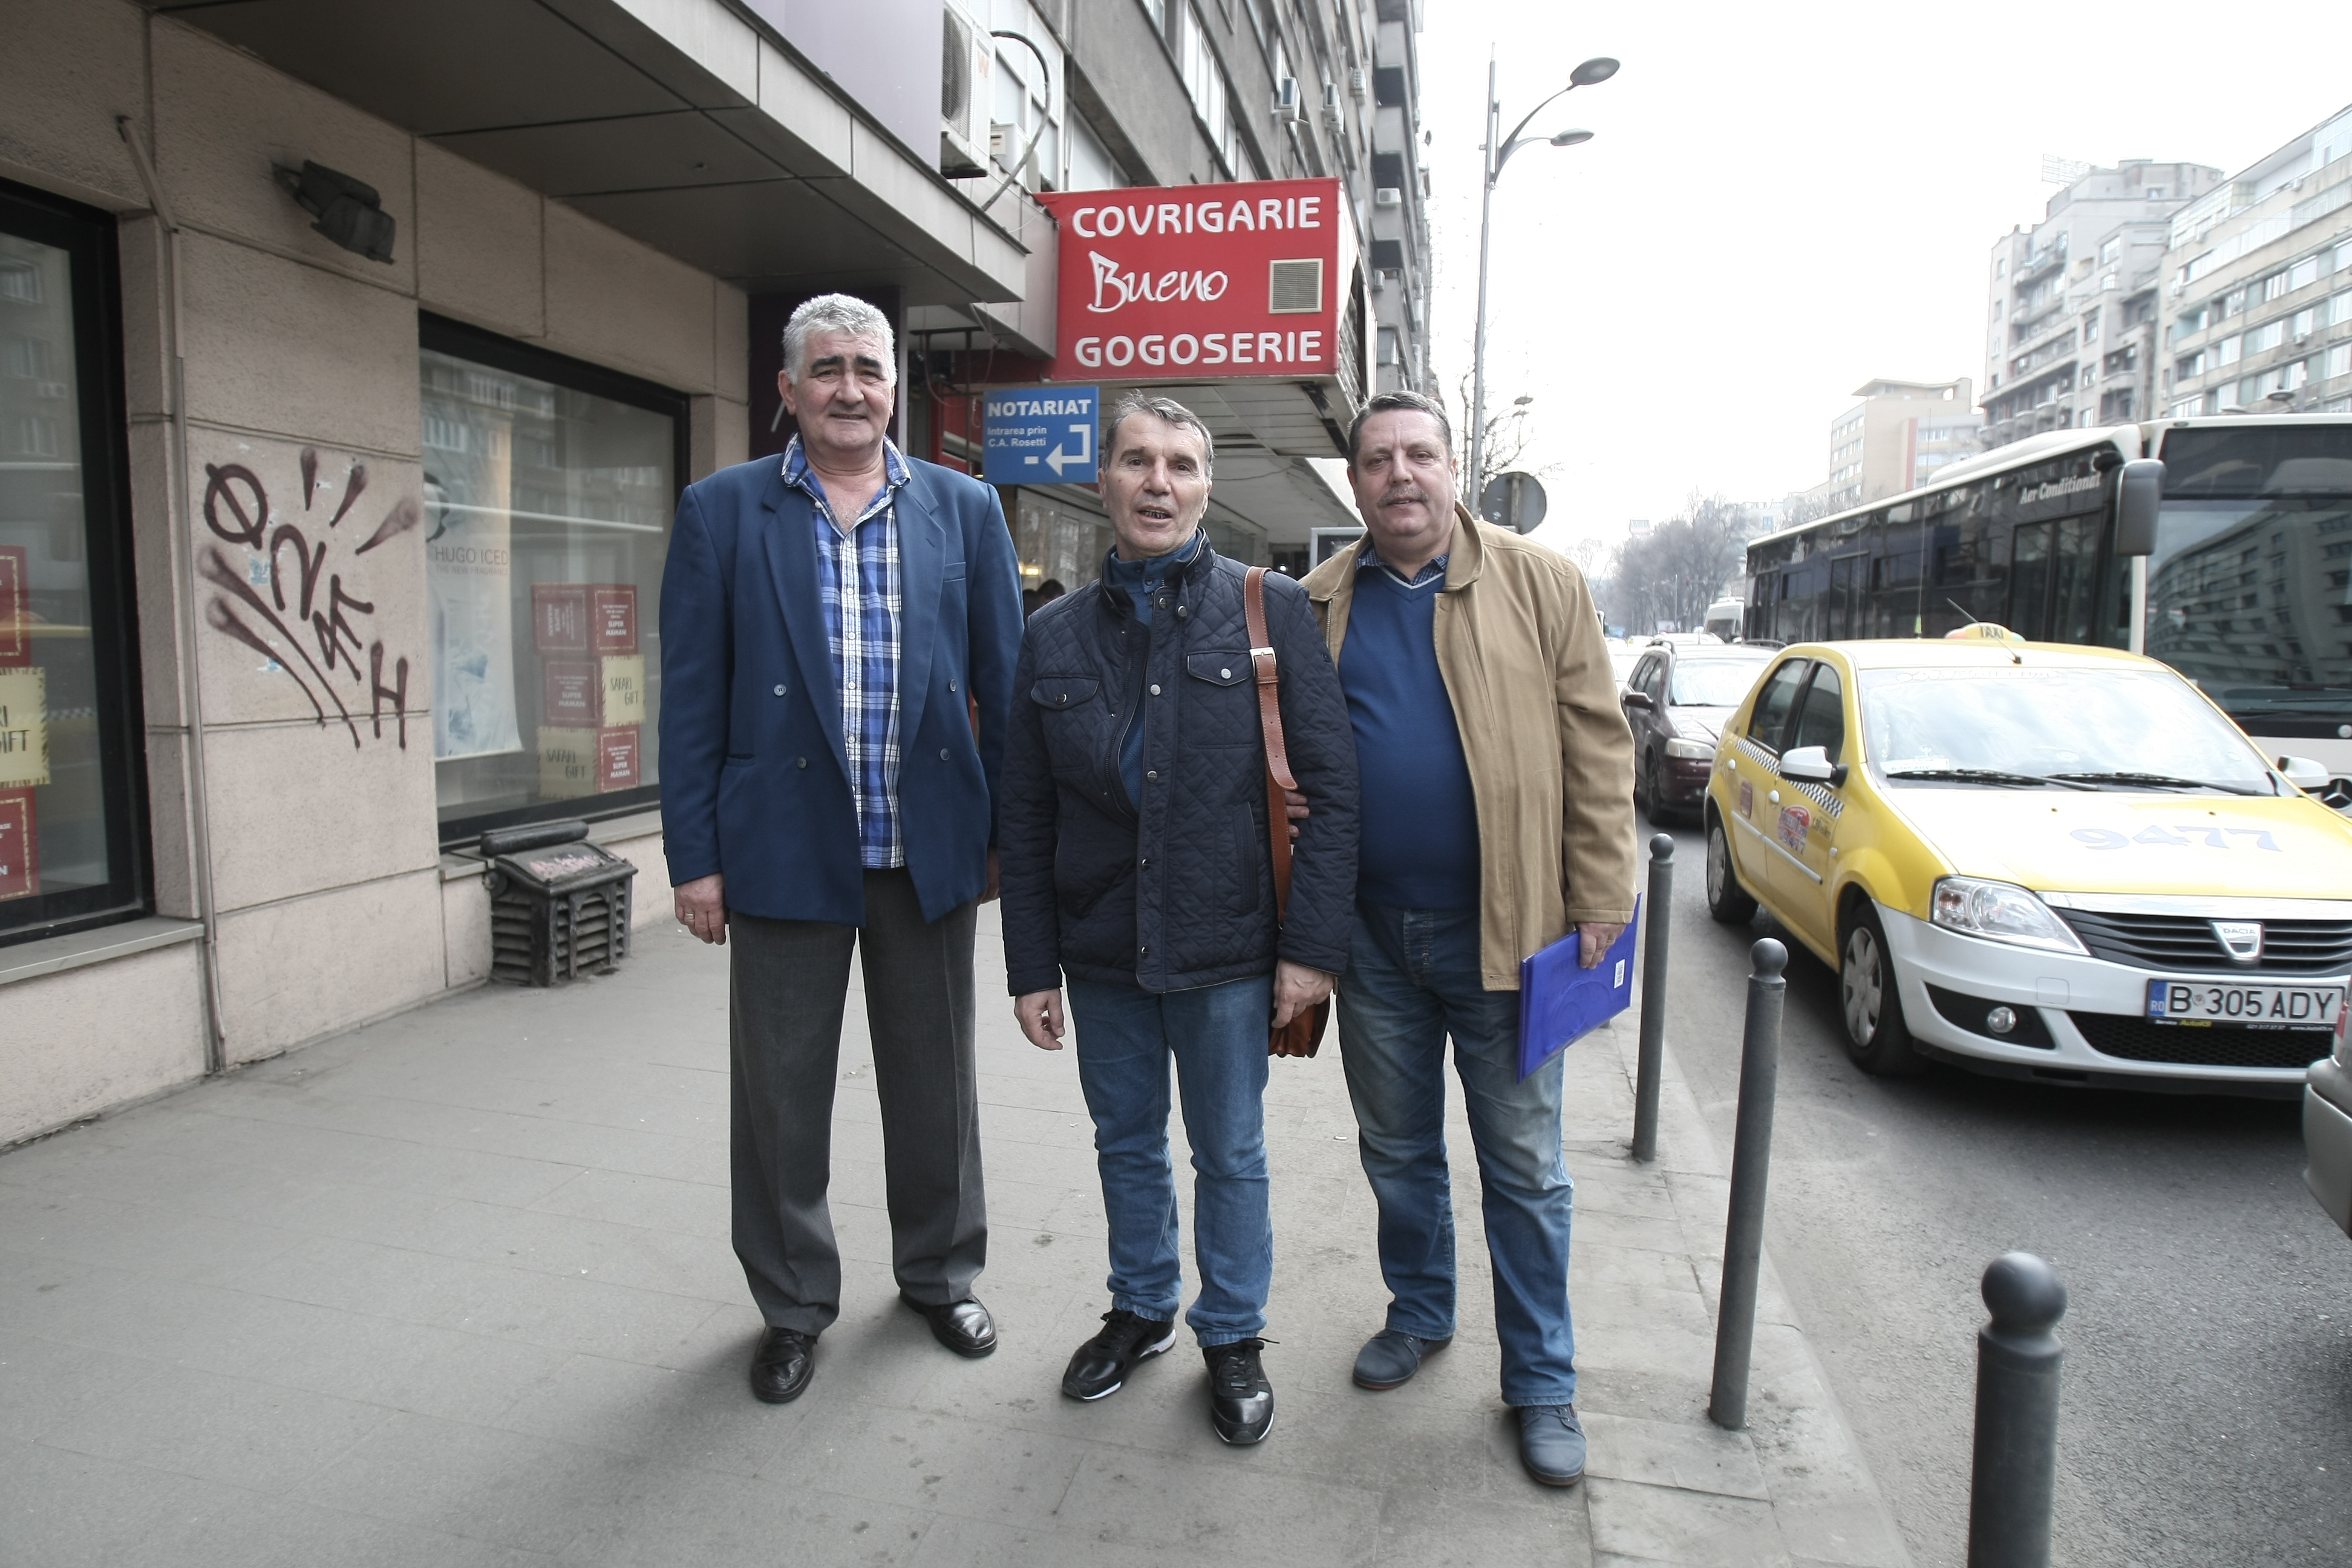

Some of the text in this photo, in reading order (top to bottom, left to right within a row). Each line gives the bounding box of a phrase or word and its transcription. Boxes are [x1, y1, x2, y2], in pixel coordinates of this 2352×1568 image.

[1073, 196, 1321, 238] COVRIGARIE
[1087, 250, 1229, 312] Bueno
[1074, 330, 1322, 367] GOGOSERIE
[988, 399, 1091, 416] NOTARIAT
[987, 426, 1047, 436] Intrarea prin
[1011, 437, 1046, 446] Rosetti
[2020, 487, 2038, 505] Aer
[435, 546, 508, 564] HUGO ICED
[610, 677, 632, 690] SAFARI
[624, 691, 638, 705] GIFT
[0, 730, 30, 754] IFT
[546, 749, 575, 763] SAFARI
[565, 765, 585, 779] GIFT
[2069, 825, 2283, 852] 9477
[2151, 1001, 2164, 1011] RO
[2170, 985, 2334, 1019] B 305 ADY
